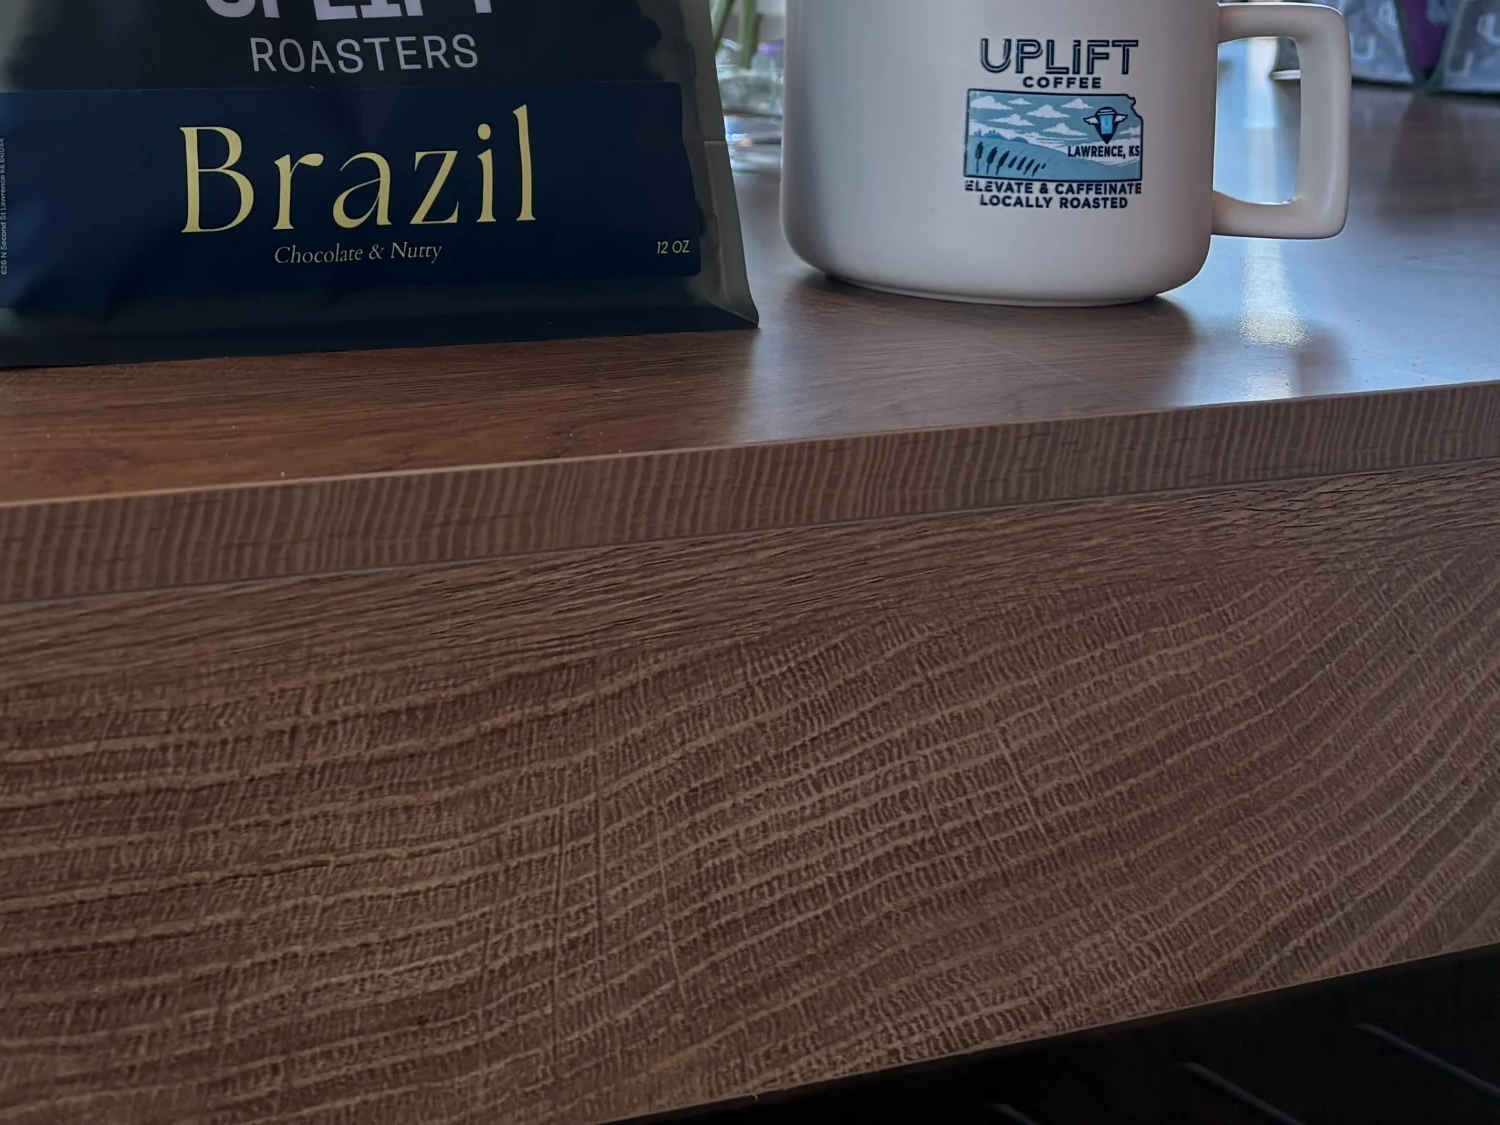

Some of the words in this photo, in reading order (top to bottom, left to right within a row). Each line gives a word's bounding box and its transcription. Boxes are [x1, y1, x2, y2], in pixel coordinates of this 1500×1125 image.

[250, 33, 479, 74] ROASTERS
[980, 38, 1139, 75] UPLIFT
[1022, 76, 1102, 89] COFFEE
[1068, 145, 1126, 159] LAWRENCE,
[1128, 145, 1140, 157] KS
[180, 104, 536, 233] Brazil
[965, 180, 1034, 194] ELEVATE
[1039, 182, 1049, 194] &
[1055, 182, 1142, 195] CAFFEINATE
[980, 194, 1053, 209] LOCALLY
[1059, 197, 1128, 209] ROASTED
[274, 243, 364, 264] Chocolate
[369, 244, 384, 260] &
[390, 241, 443, 264] Nutty
[657, 241, 669, 254] 12
[672, 240, 690, 254] OZ
